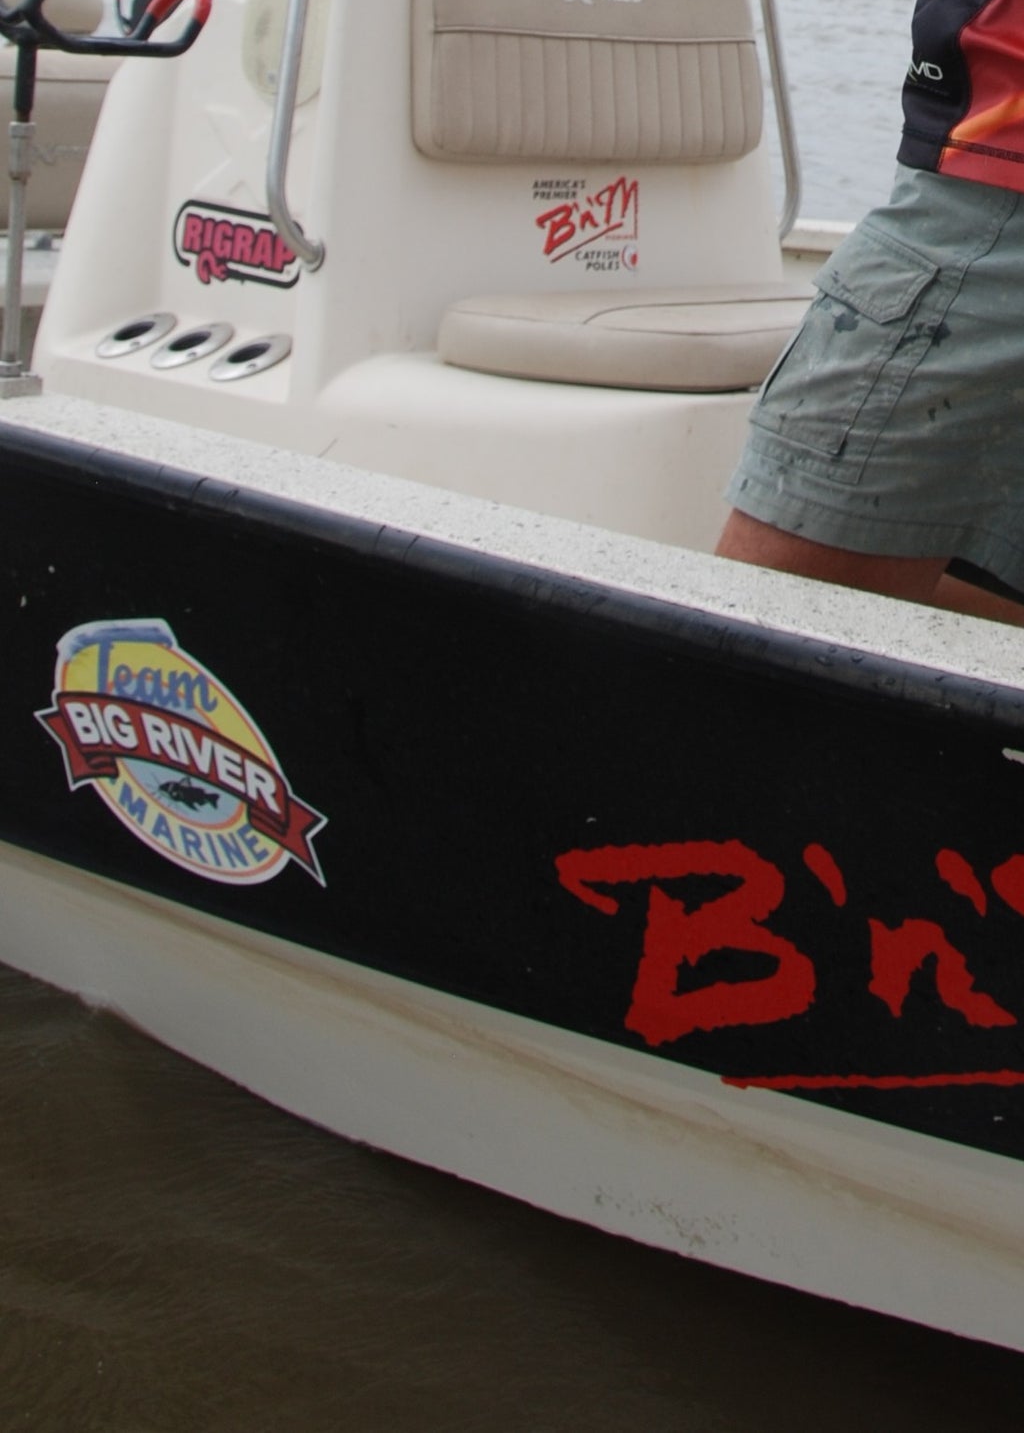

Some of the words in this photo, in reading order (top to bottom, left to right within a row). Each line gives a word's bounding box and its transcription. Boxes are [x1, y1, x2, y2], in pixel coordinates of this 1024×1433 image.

[532, 179, 587, 189] AMERICA'S
[532, 190, 578, 200] PREMIER
[574, 249, 621, 262] CATFISH
[585, 260, 621, 272] POLES
[66, 624, 220, 713] Team
[64, 701, 139, 750] BIG
[140, 712, 282, 816] RIVER
[118, 783, 270, 870] MARINE
